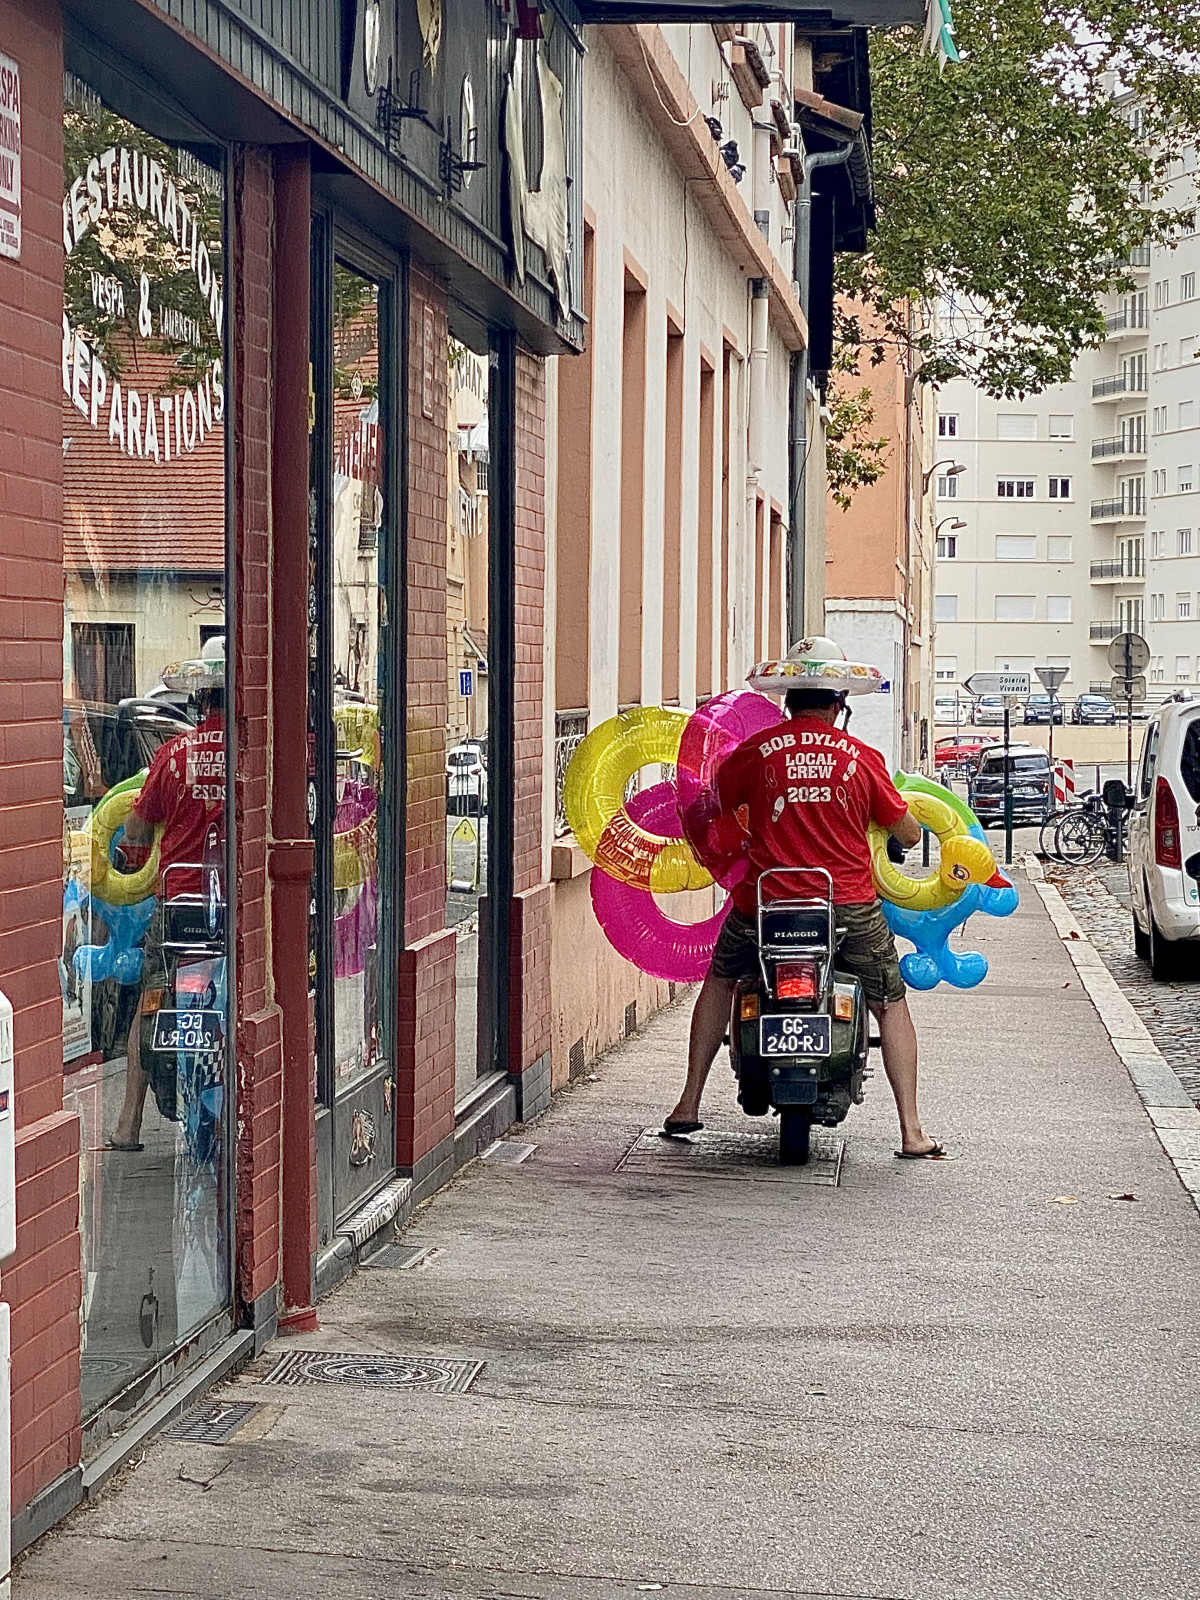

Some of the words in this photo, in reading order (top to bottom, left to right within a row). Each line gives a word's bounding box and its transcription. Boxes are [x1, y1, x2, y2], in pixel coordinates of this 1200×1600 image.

[91, 271, 124, 318] VESPA
[138, 271, 152, 338] &
[999, 676, 1026, 684] Soierie
[758, 733, 797, 758] BOB
[801, 732, 861, 759] DYLAN
[785, 752, 837, 767] LOCAL
[787, 765, 834, 780] CREW
[787, 786, 832, 803] 2023
[782, 1018, 809, 1035] GG-
[767, 1035, 824, 1052] 240-RJ
